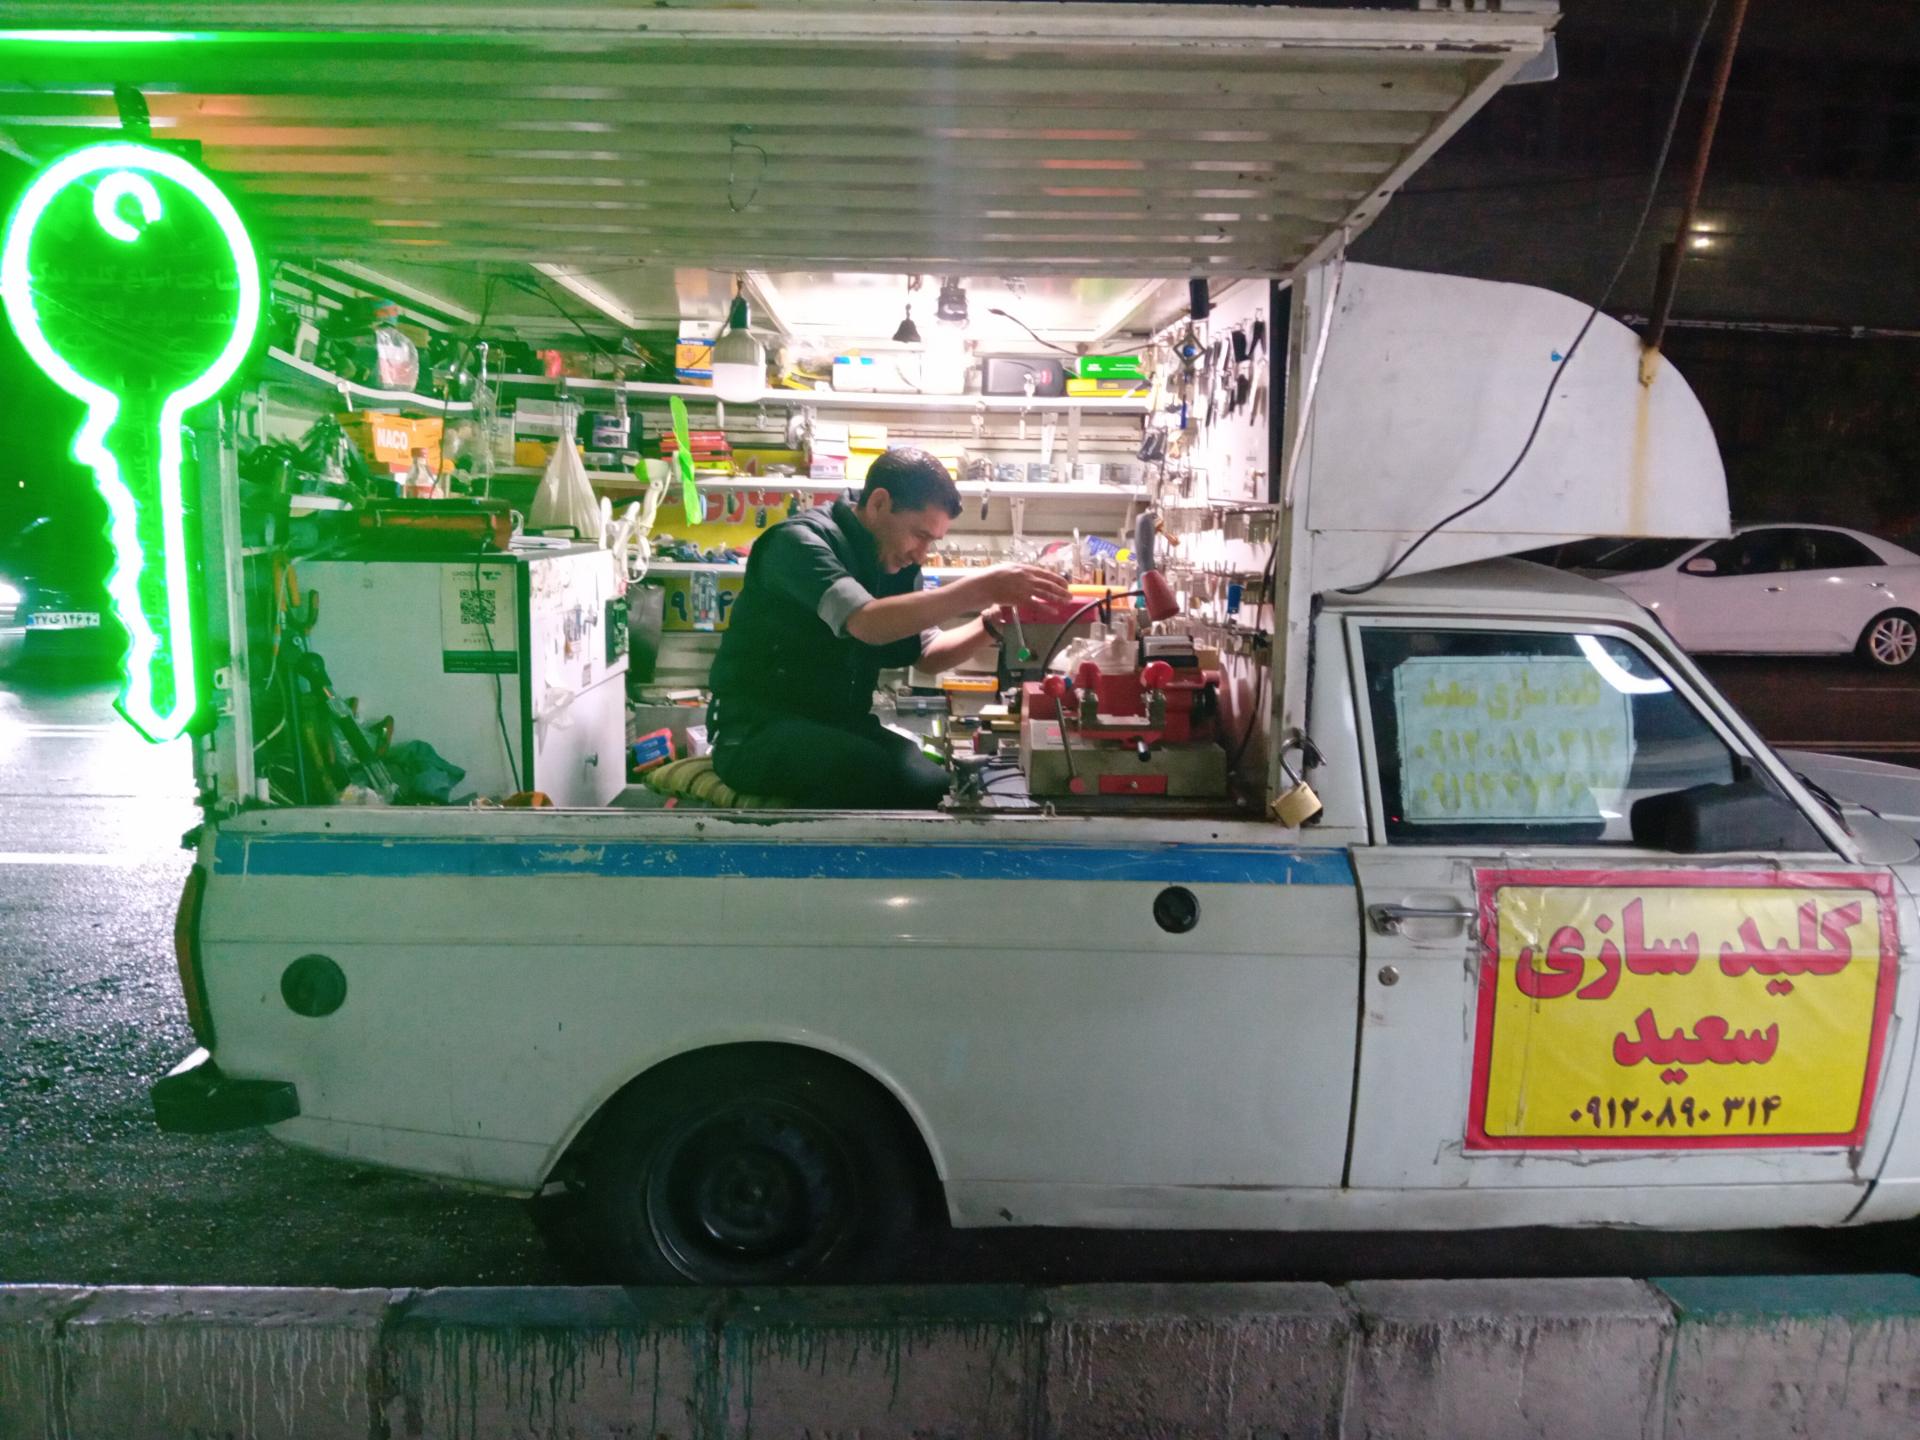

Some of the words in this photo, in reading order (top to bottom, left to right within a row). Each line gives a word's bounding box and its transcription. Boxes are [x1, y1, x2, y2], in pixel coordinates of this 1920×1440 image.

[1514, 896, 1700, 1000] سازی
[1719, 899, 1863, 996] کلید
[1612, 1008, 1779, 1085] سعید
